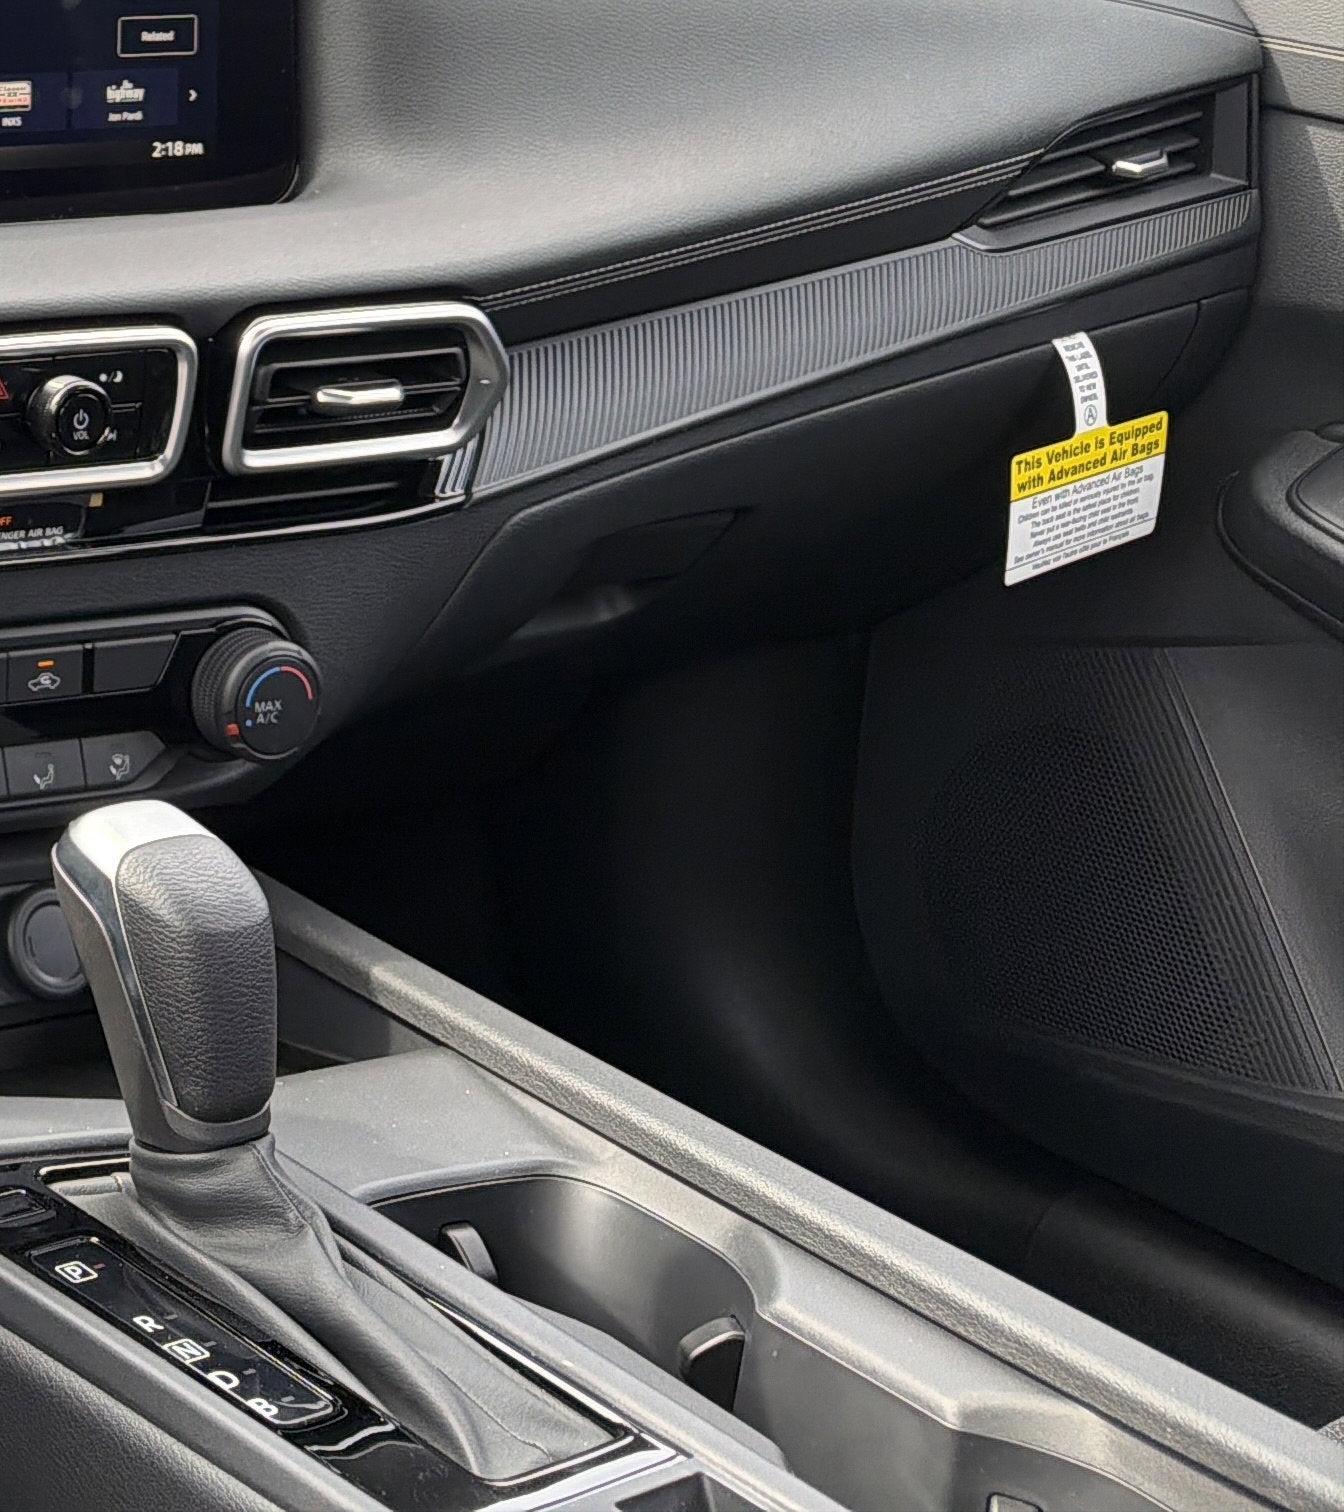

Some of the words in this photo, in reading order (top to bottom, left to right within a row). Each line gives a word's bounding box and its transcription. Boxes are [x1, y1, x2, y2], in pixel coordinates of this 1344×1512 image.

[72, 430, 90, 441] VOL
[1016, 457, 1042, 475] This
[1046, 443, 1091, 464] Vehicle
[1095, 436, 1105, 451] is
[1109, 417, 1163, 445] Equipped
[1017, 475, 1044, 493] with
[1048, 455, 1107, 484] Advanced
[1111, 448, 1128, 464] Air
[1131, 438, 1160, 456] Bags
[1032, 495, 1052, 509] Even
[1072, 475, 1109, 495] Advanced
[1124, 465, 1143, 478] Bags
[27, 528, 44, 537] AIR
[45, 526, 64, 536] BAG
[254, 699, 282, 713] MAX
[256, 711, 279, 724] A/C
[132, 1315, 165, 1333] R
[207, 1370, 241, 1391] D
[246, 1398, 279, 1418] B
